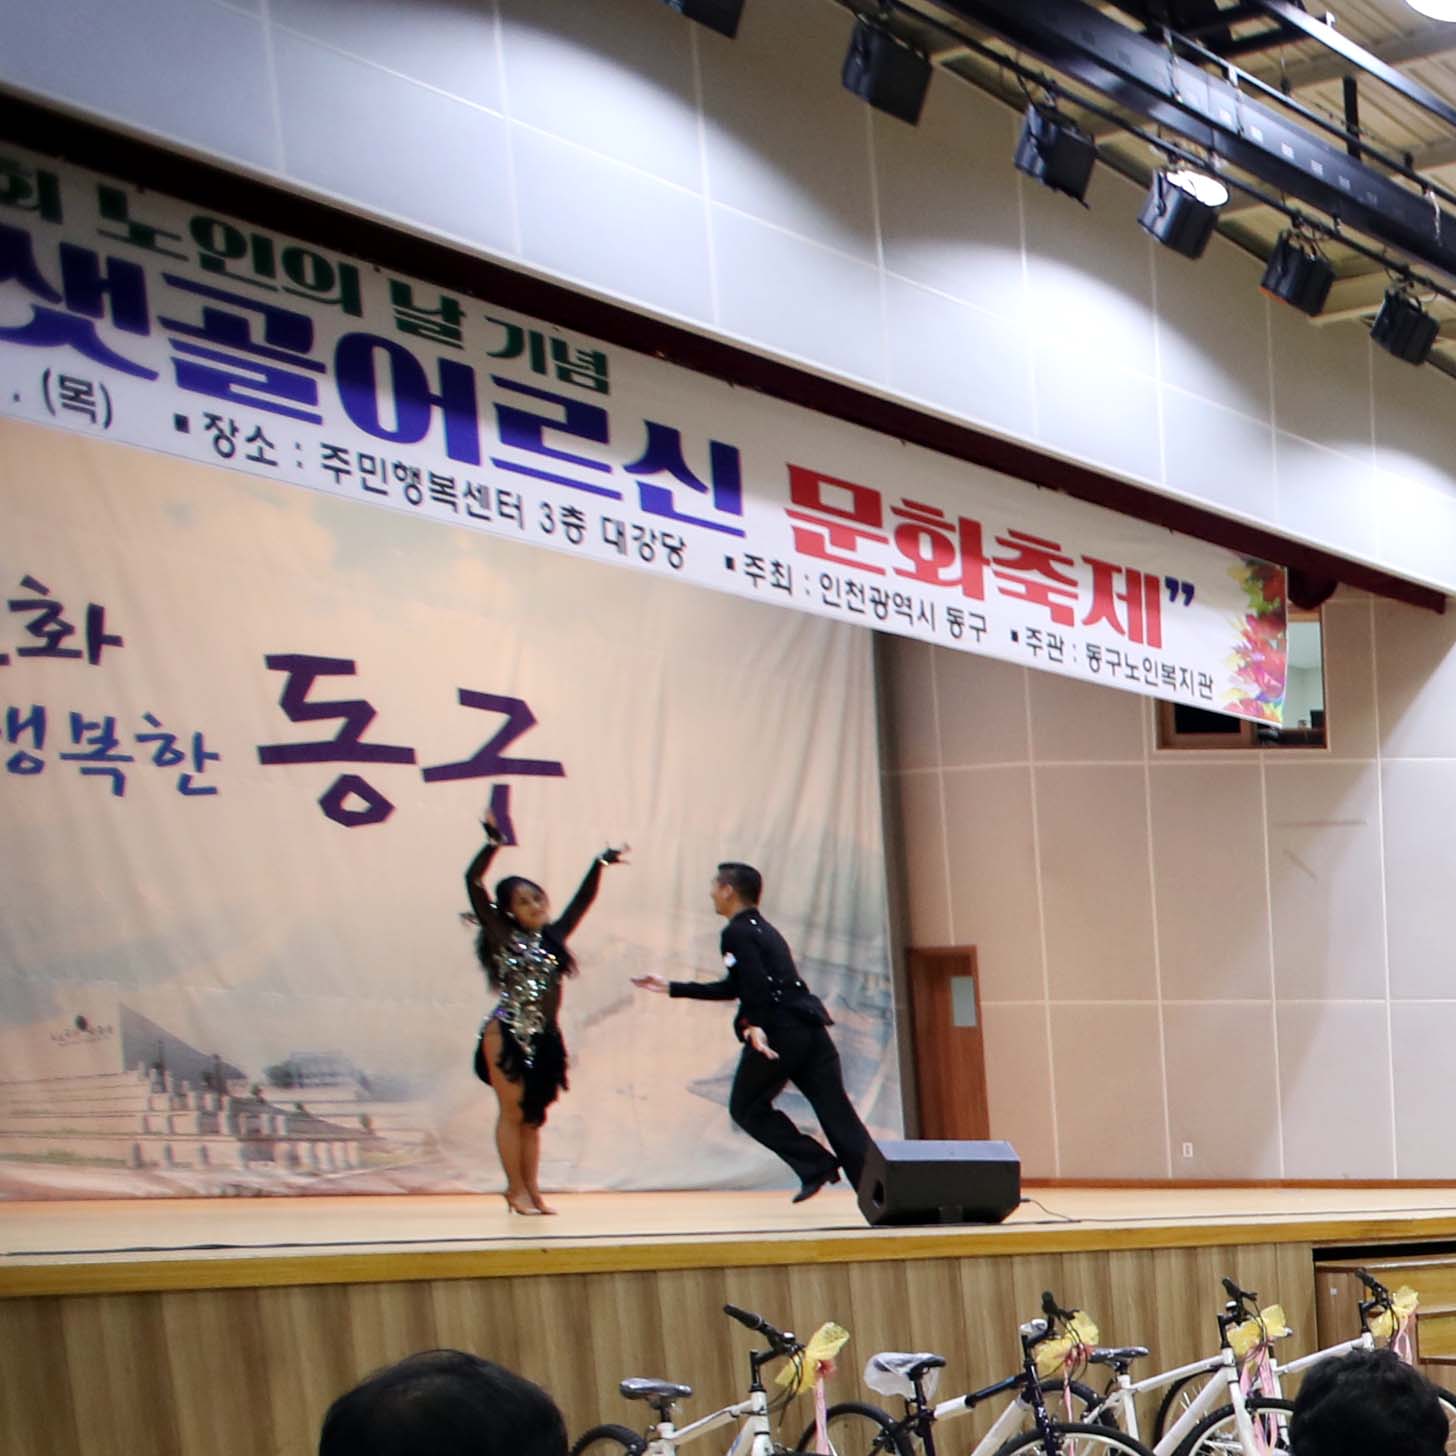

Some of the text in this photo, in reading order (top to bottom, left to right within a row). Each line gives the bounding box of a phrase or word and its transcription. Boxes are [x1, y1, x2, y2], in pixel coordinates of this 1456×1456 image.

[96, 183, 363, 318] 노인의
[386, 277, 469, 350] 날
[483, 315, 611, 396] 기념
[0, 574, 124, 666] 화
[319, 441, 526, 531] 주민행복센터
[538, 501, 588, 546] 3층
[601, 514, 688, 571] 대강당
[818, 573, 938, 633] 인천광역시
[945, 607, 988, 645] 동구
[1084, 642, 1215, 701] 동구노인복지관
[257, 653, 567, 848] 동구
